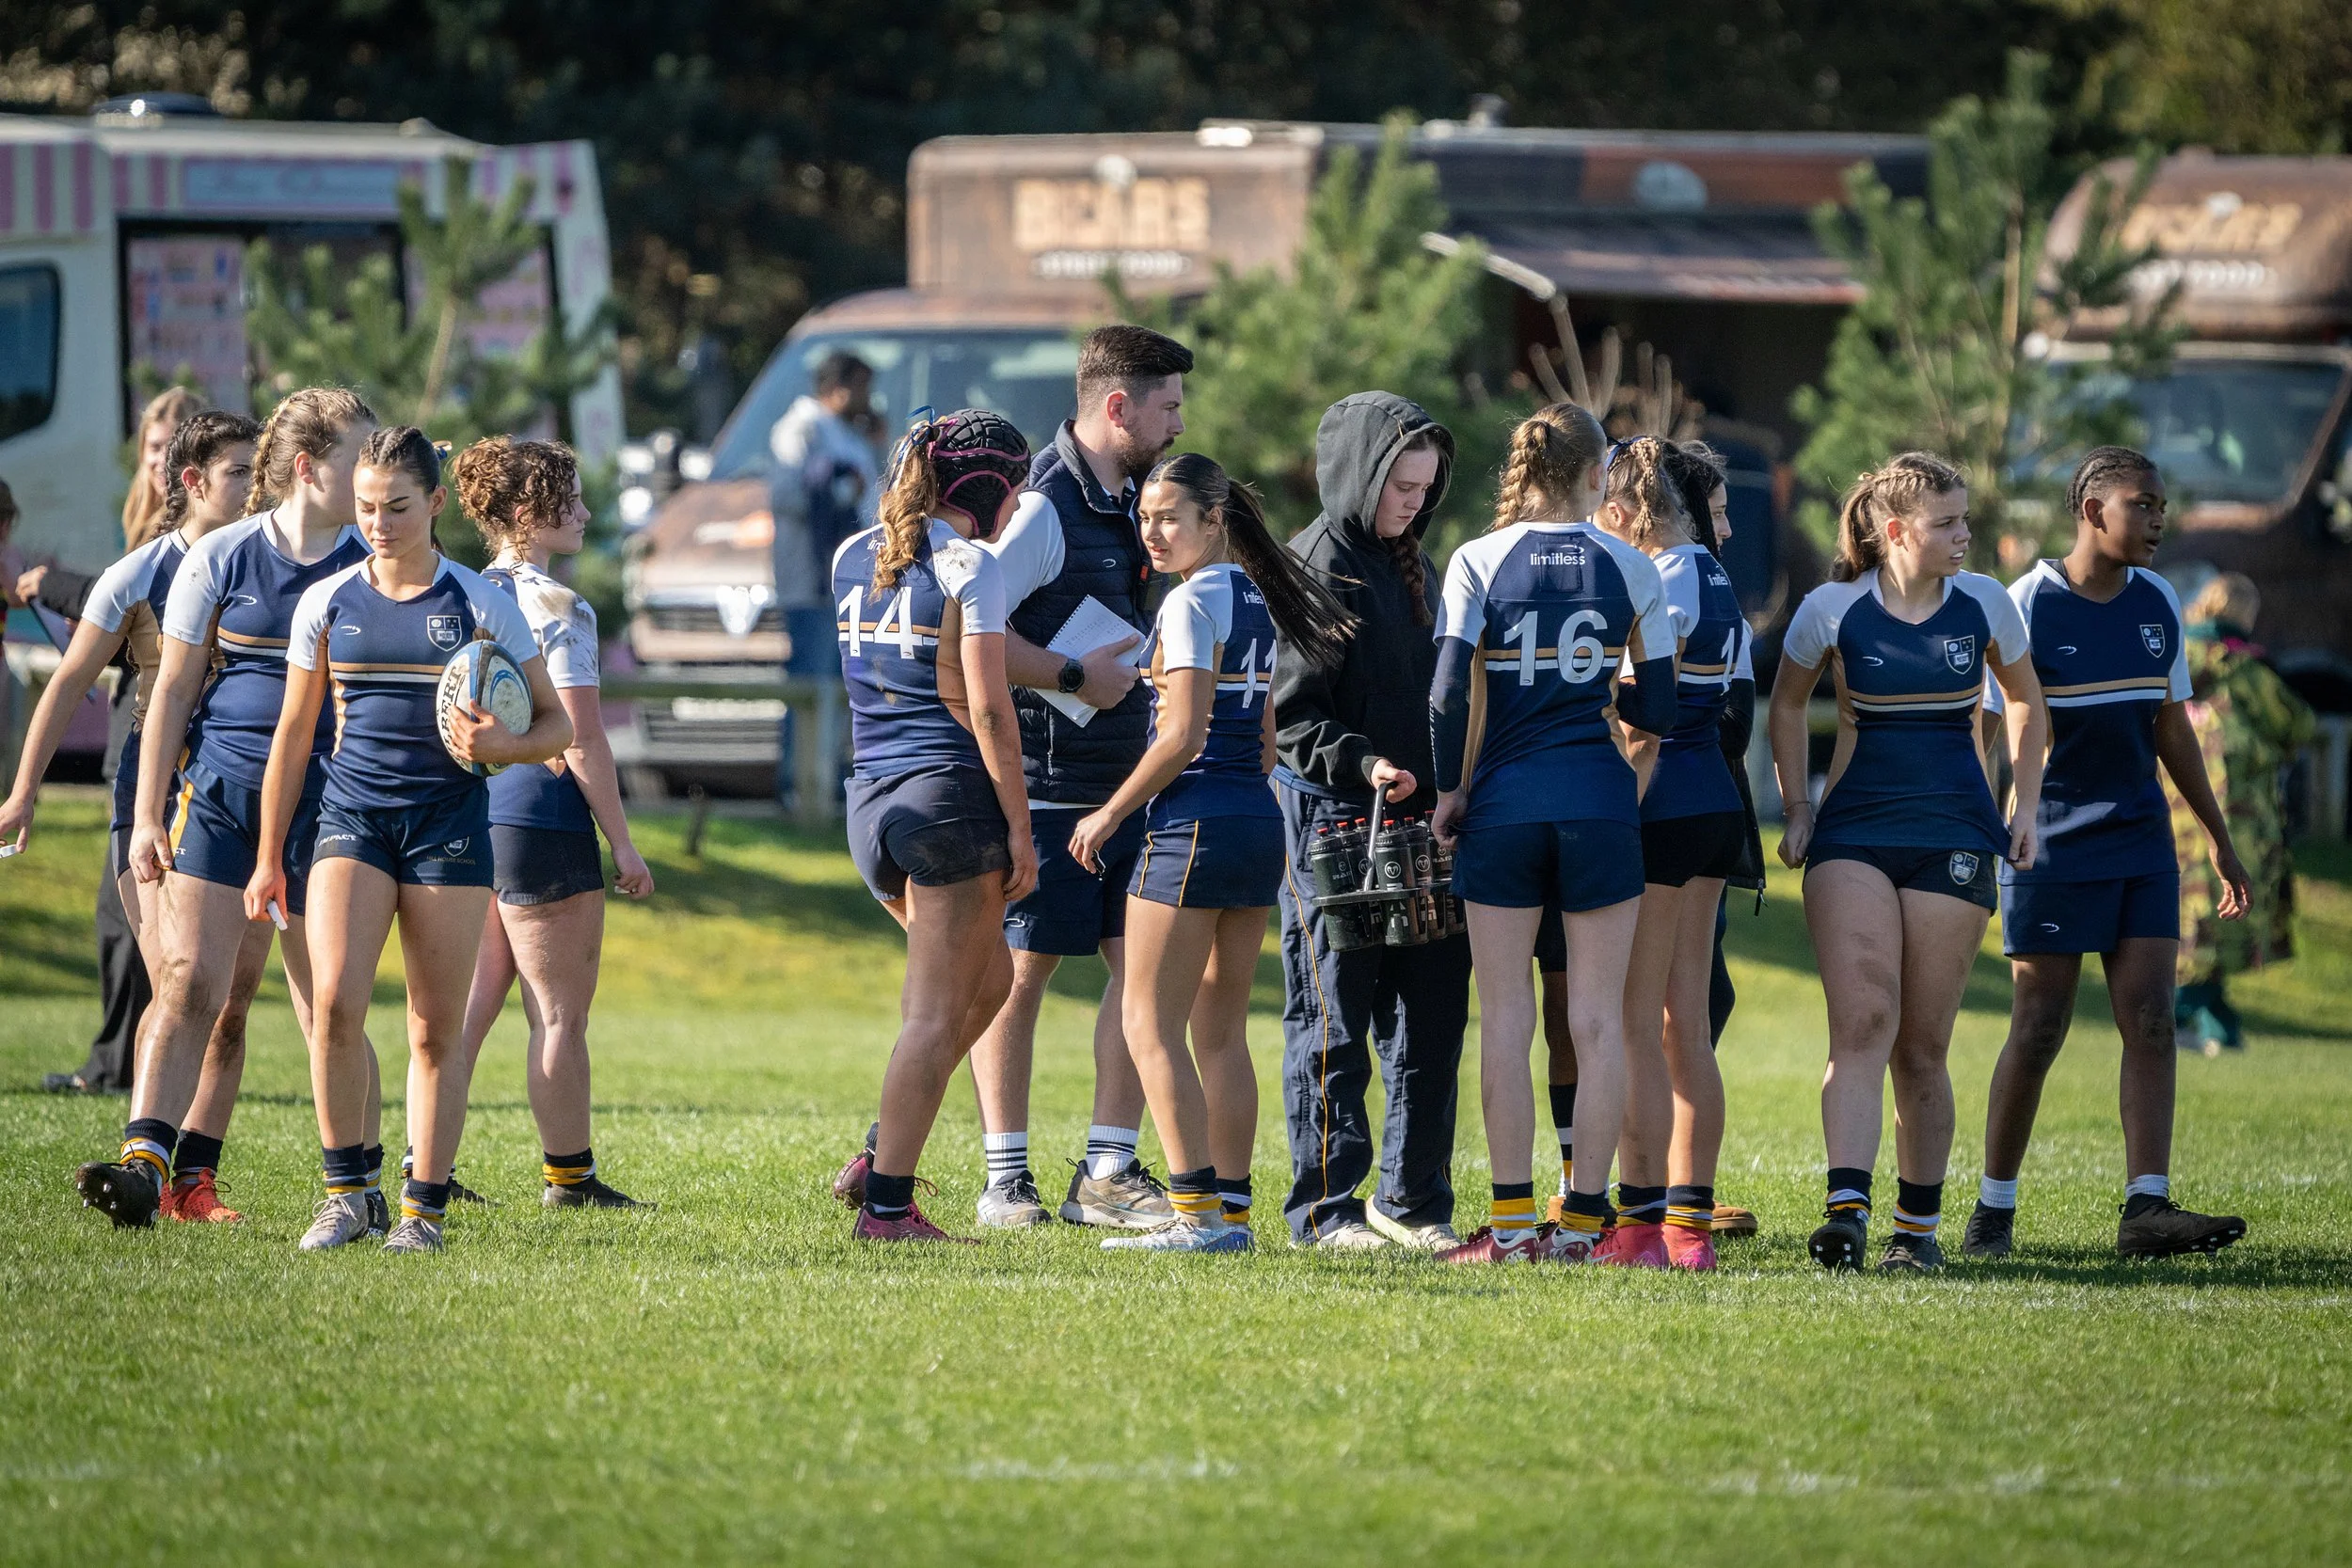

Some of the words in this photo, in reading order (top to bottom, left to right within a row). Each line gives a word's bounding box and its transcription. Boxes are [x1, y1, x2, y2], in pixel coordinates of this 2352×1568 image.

[1530, 553, 1586, 566] limitless
[838, 585, 923, 660] 14
[1503, 610, 1609, 687] 16
[1240, 638, 1279, 710] 11
